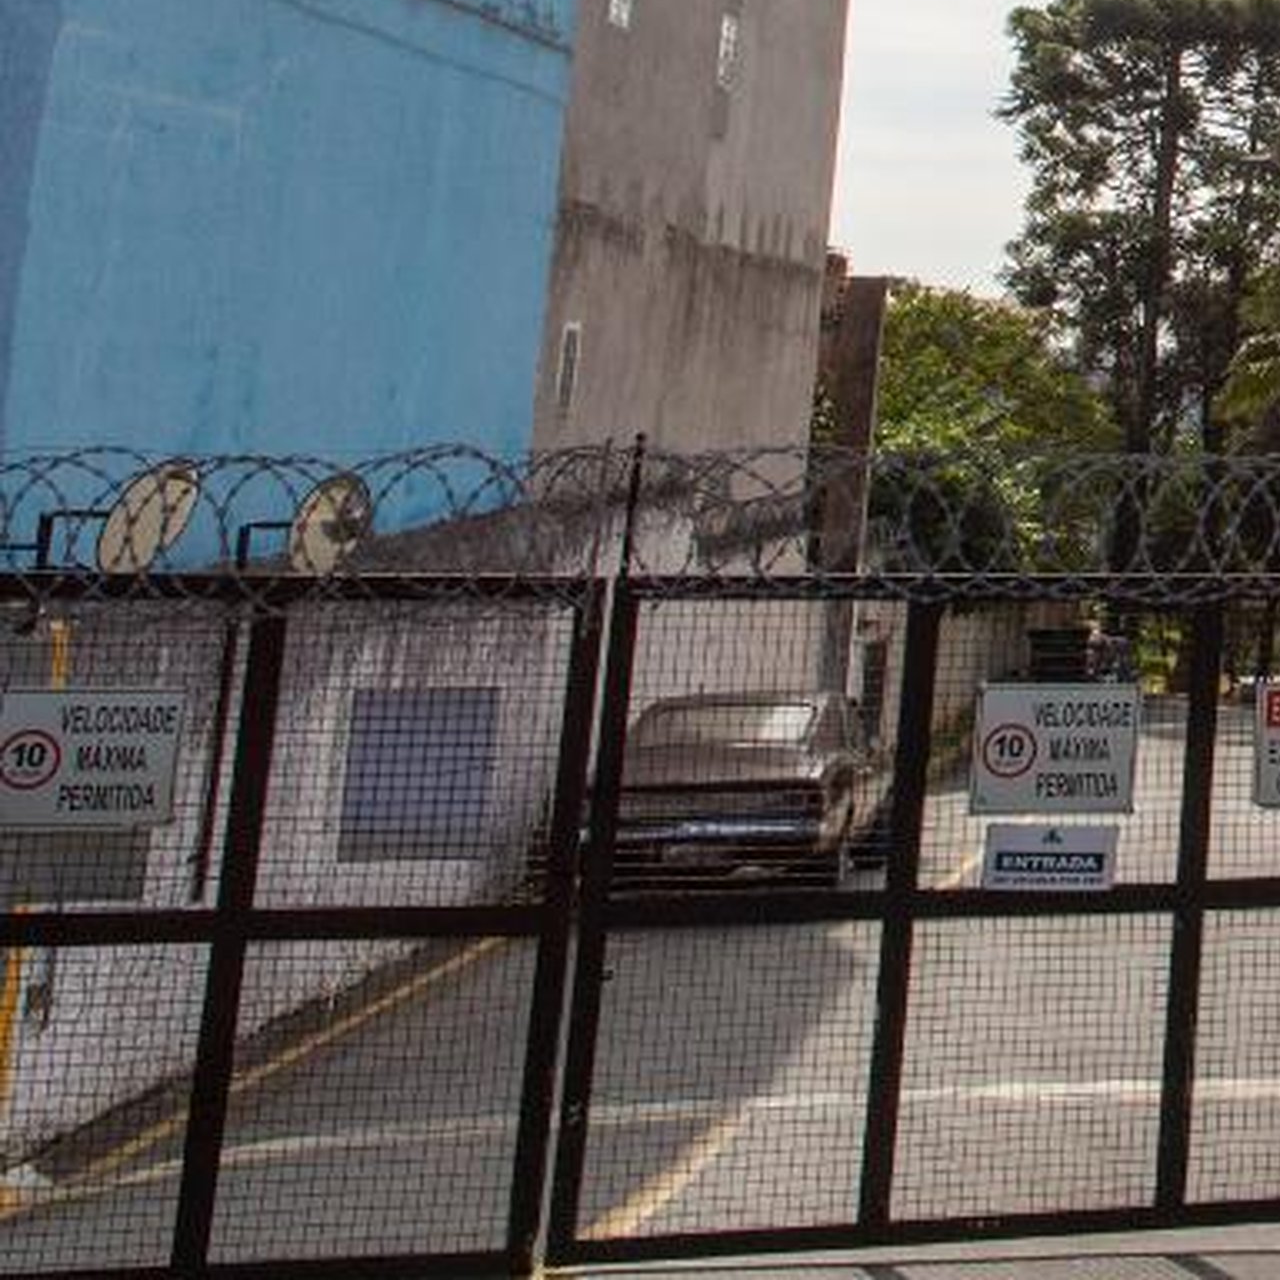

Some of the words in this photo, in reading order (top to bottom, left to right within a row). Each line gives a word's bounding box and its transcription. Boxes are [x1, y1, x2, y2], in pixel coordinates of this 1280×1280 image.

[62, 705, 177, 734] VELOCIDADE
[1034, 702, 1132, 728] VELOCIDADE
[10, 742, 46, 767] 10
[994, 734, 1024, 758] 10
[58, 783, 155, 811] PERMITIDA
[1036, 772, 1118, 798] PERMITIDA
[1001, 856, 1098, 869] ENTRADA
